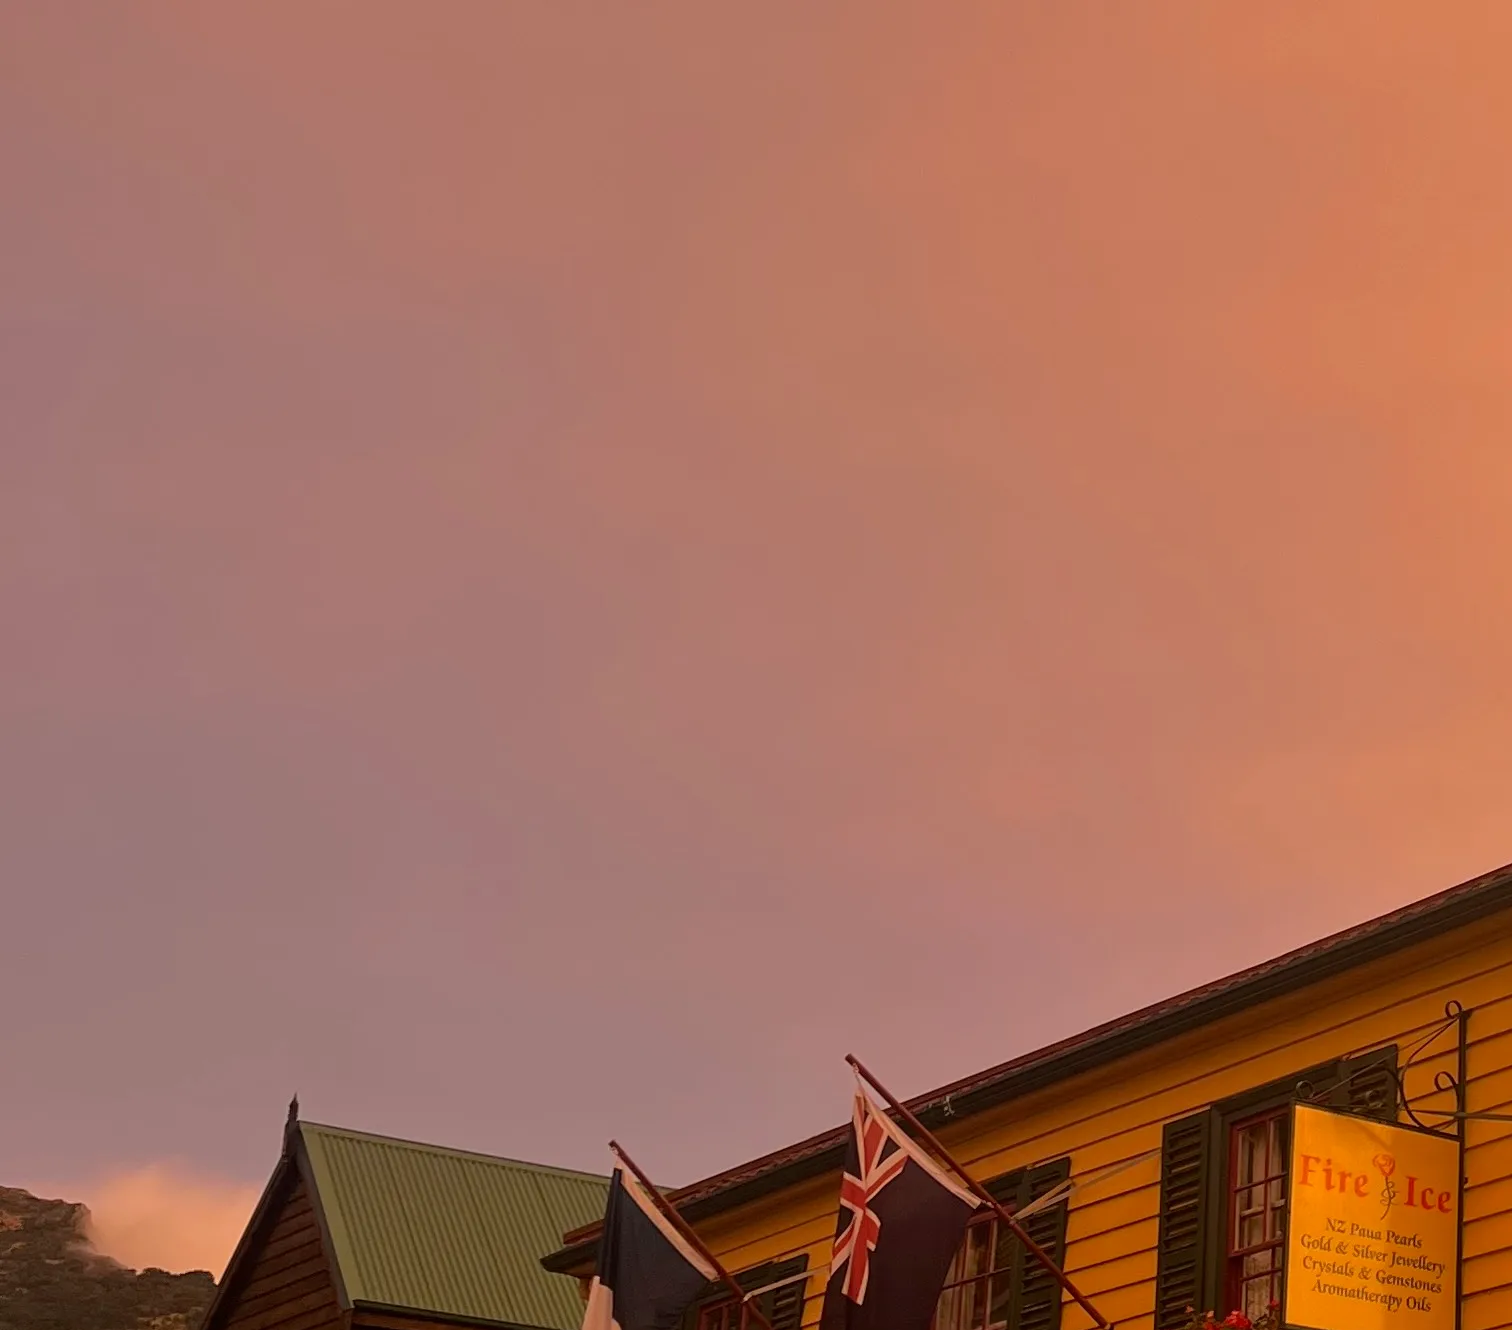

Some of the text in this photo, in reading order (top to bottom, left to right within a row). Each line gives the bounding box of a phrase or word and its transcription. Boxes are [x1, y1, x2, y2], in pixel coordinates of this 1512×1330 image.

[1298, 1154, 1370, 1198] Fire
[1404, 1176, 1453, 1213] Ice
[1325, 1217, 1423, 1249] NZ Paua Pearls
[1300, 1233, 1446, 1279] Gold & Silver Jewellery
[1302, 1255, 1442, 1294] Crystals & Gemstones
[1312, 1279, 1432, 1313] Aromatherapy Oils
